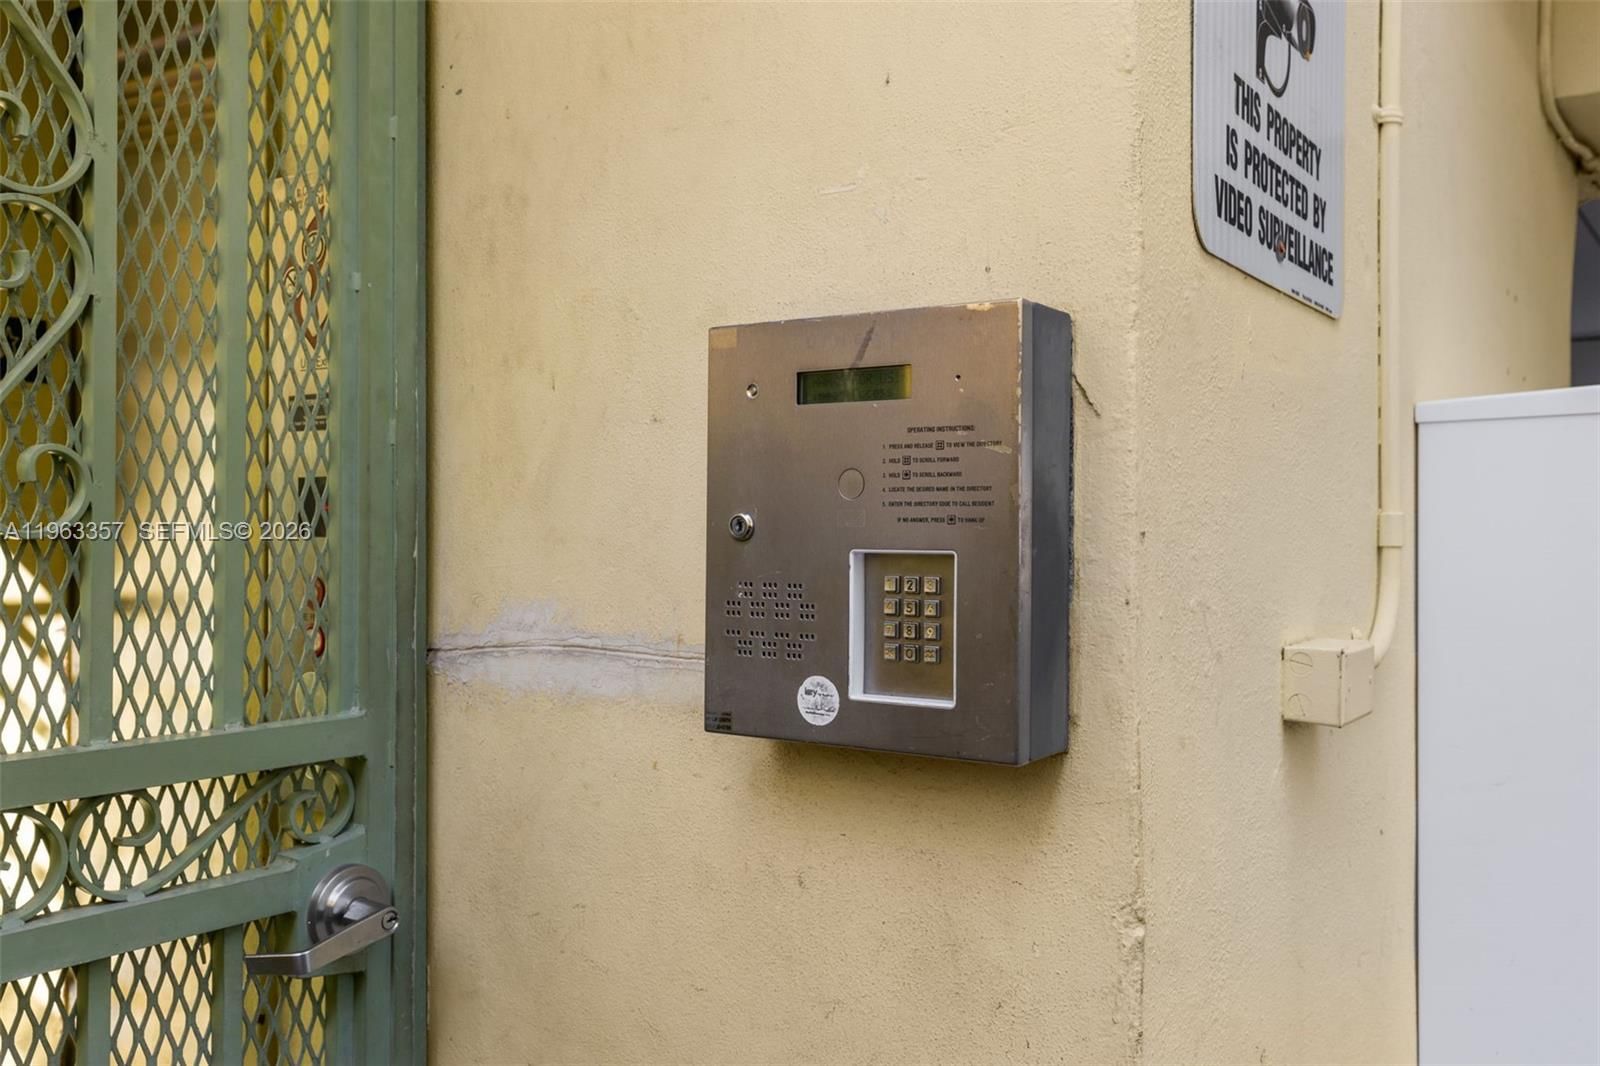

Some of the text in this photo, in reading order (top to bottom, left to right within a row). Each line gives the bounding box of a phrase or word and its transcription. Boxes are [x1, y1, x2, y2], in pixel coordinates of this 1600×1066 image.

[1226, 124, 1326, 234] IS PROTECTED BY
[1234, 72, 1321, 181] THIS PROPERTY
[1215, 174, 1334, 286] VIDEO SURVEILLANCE
